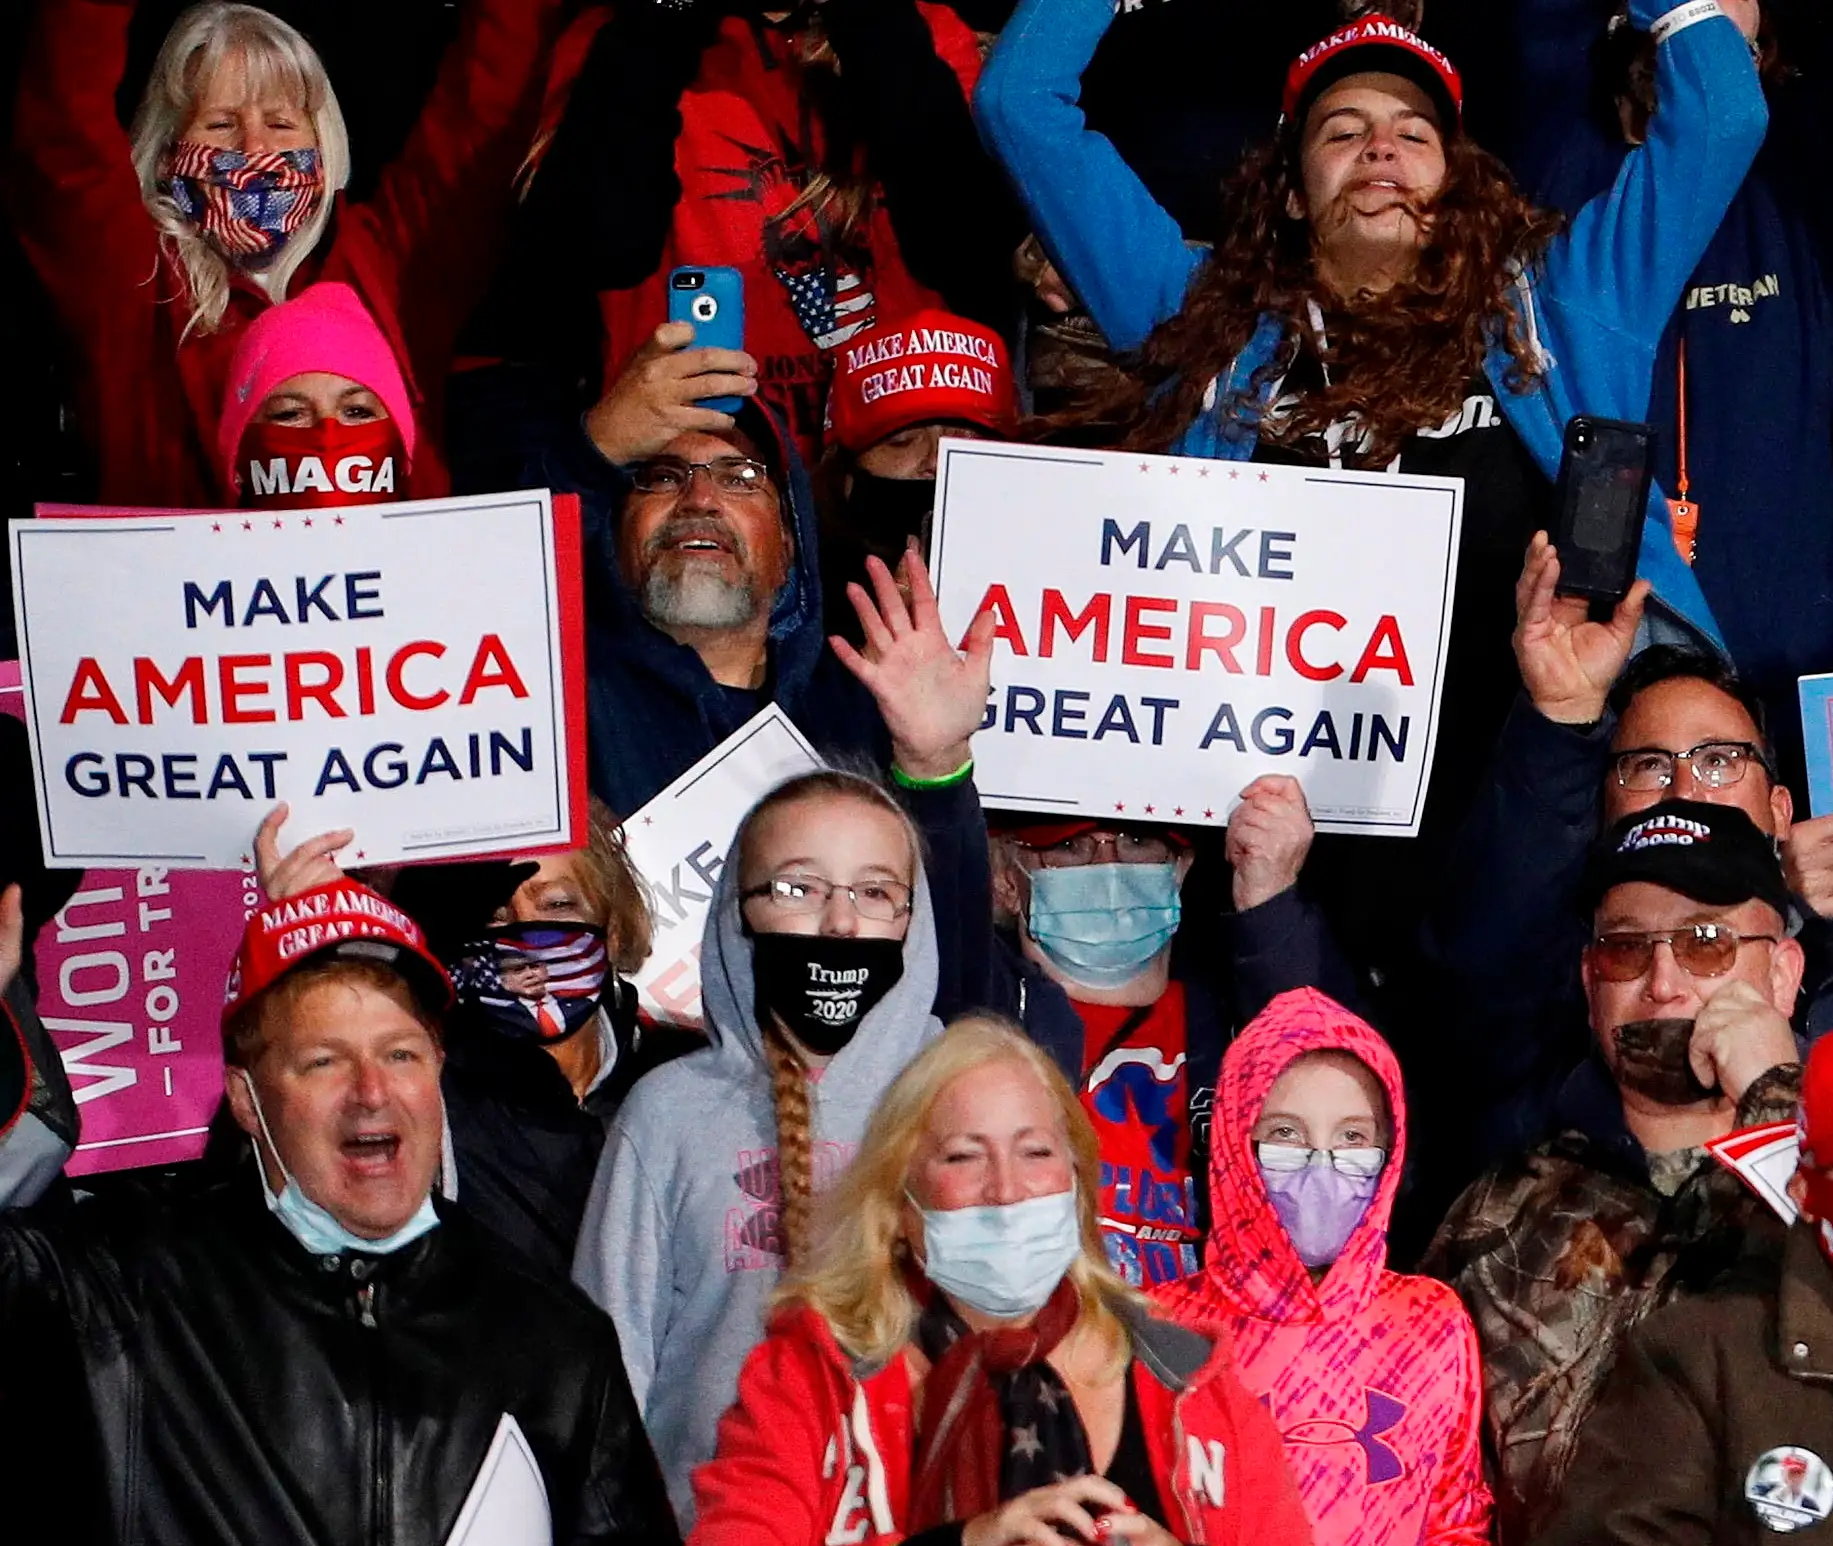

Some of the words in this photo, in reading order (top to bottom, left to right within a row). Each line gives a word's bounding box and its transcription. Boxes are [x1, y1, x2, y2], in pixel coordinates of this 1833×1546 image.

[846, 333, 904, 376] MAKE
[906, 329, 998, 368] AMERICA
[861, 363, 927, 404] GREAT
[928, 364, 992, 395] AGAIN
[251, 455, 394, 495] MAGA
[1100, 518, 1297, 580] MAKE
[183, 571, 384, 628] MAKE
[958, 584, 1414, 686] AMERICA
[59, 634, 530, 724] AMERICA
[1199, 702, 1411, 762] AGAIN
[64, 752, 287, 799] GREAT
[313, 727, 533, 796] AGAIN
[1620, 815, 1710, 851] Trump
[261, 894, 328, 933] MAKE
[278, 921, 350, 960] GREAT
[807, 963, 869, 985] Trump
[144, 947, 182, 1055] FOR
[812, 1001, 859, 1021] 2020
